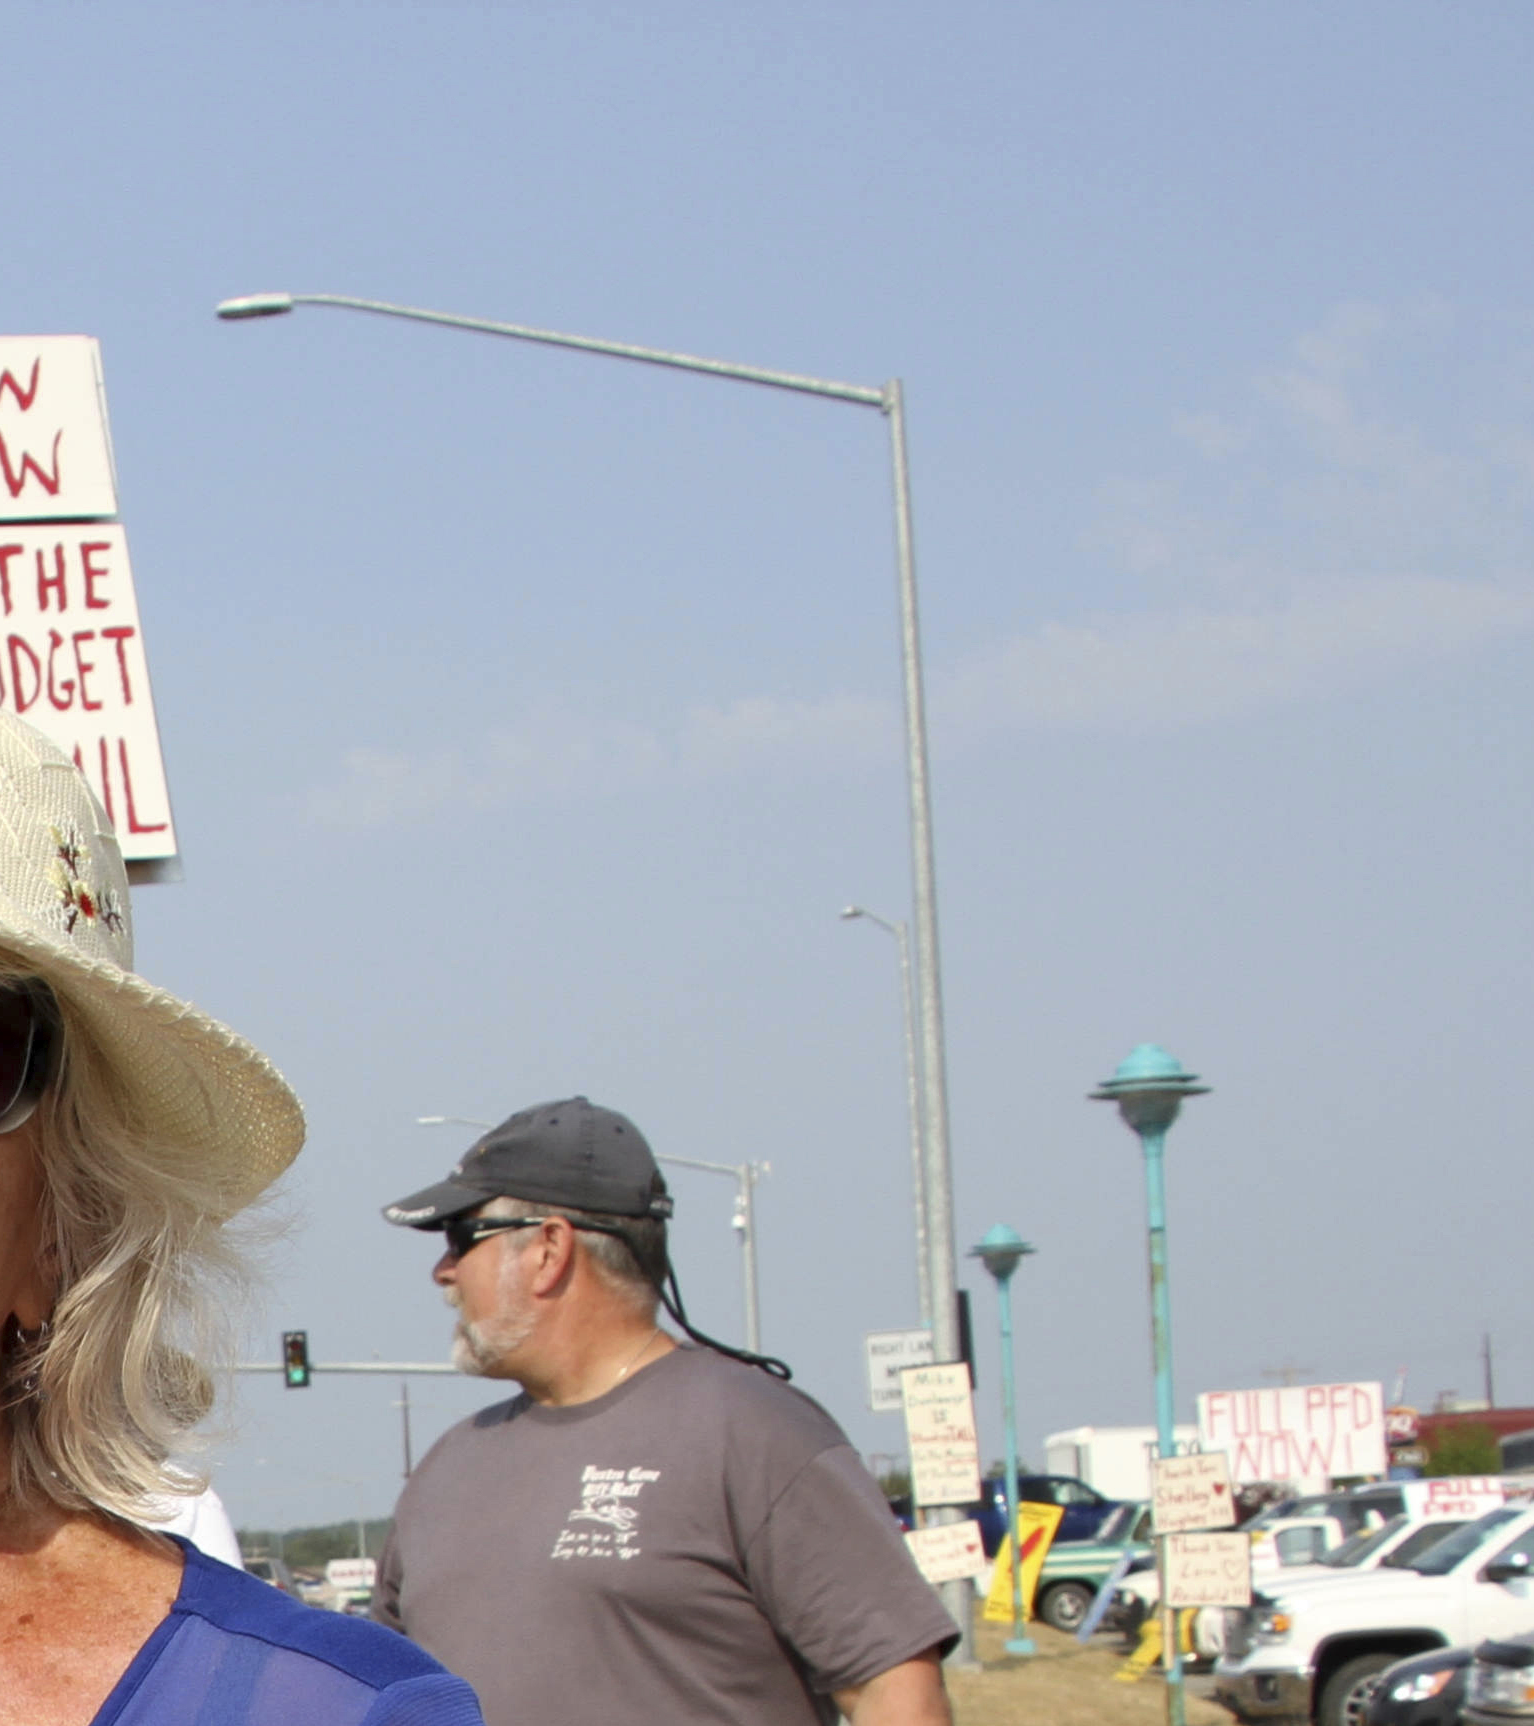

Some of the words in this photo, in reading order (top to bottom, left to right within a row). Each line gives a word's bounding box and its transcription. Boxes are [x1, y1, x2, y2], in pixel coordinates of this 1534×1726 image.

[73, 736, 168, 834] IL
[1208, 1390, 1281, 1439] FULL
[1305, 1384, 1373, 1434] PFD
